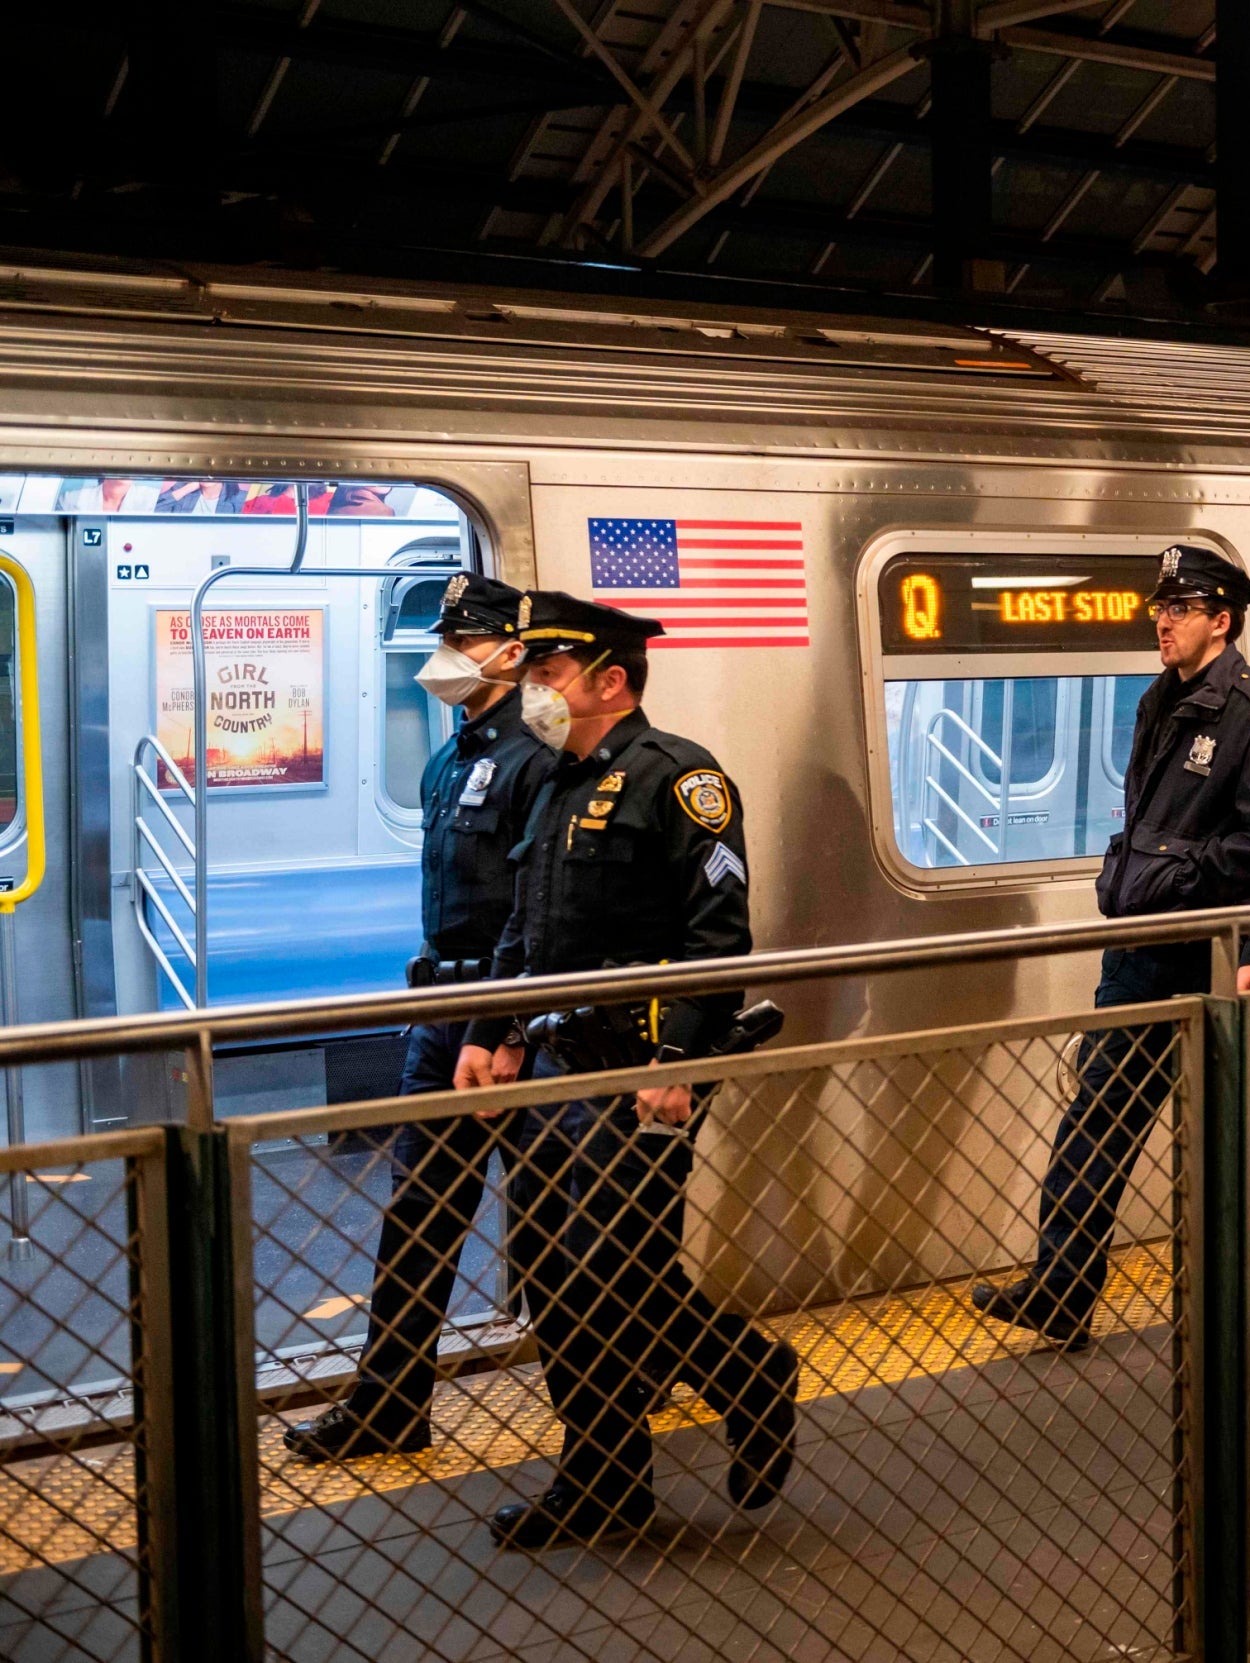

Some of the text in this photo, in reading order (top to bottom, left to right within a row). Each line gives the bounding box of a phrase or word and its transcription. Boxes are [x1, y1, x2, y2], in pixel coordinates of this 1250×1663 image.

[84, 530, 101, 544] L7
[902, 574, 1140, 639] Q LAST STOP
[219, 616, 232, 628] AS
[235, 615, 281, 628] MORTALS
[283, 615, 310, 627] COME
[170, 629, 188, 640] TO
[246, 628, 265, 639] ON
[217, 663, 270, 685] GIRL
[210, 690, 276, 711] NORTH
[288, 697, 310, 708] DYLAN
[213, 712, 273, 734] COUNTRY
[218, 767, 288, 778] BROADWAY
[680, 774, 723, 797] POLICE
